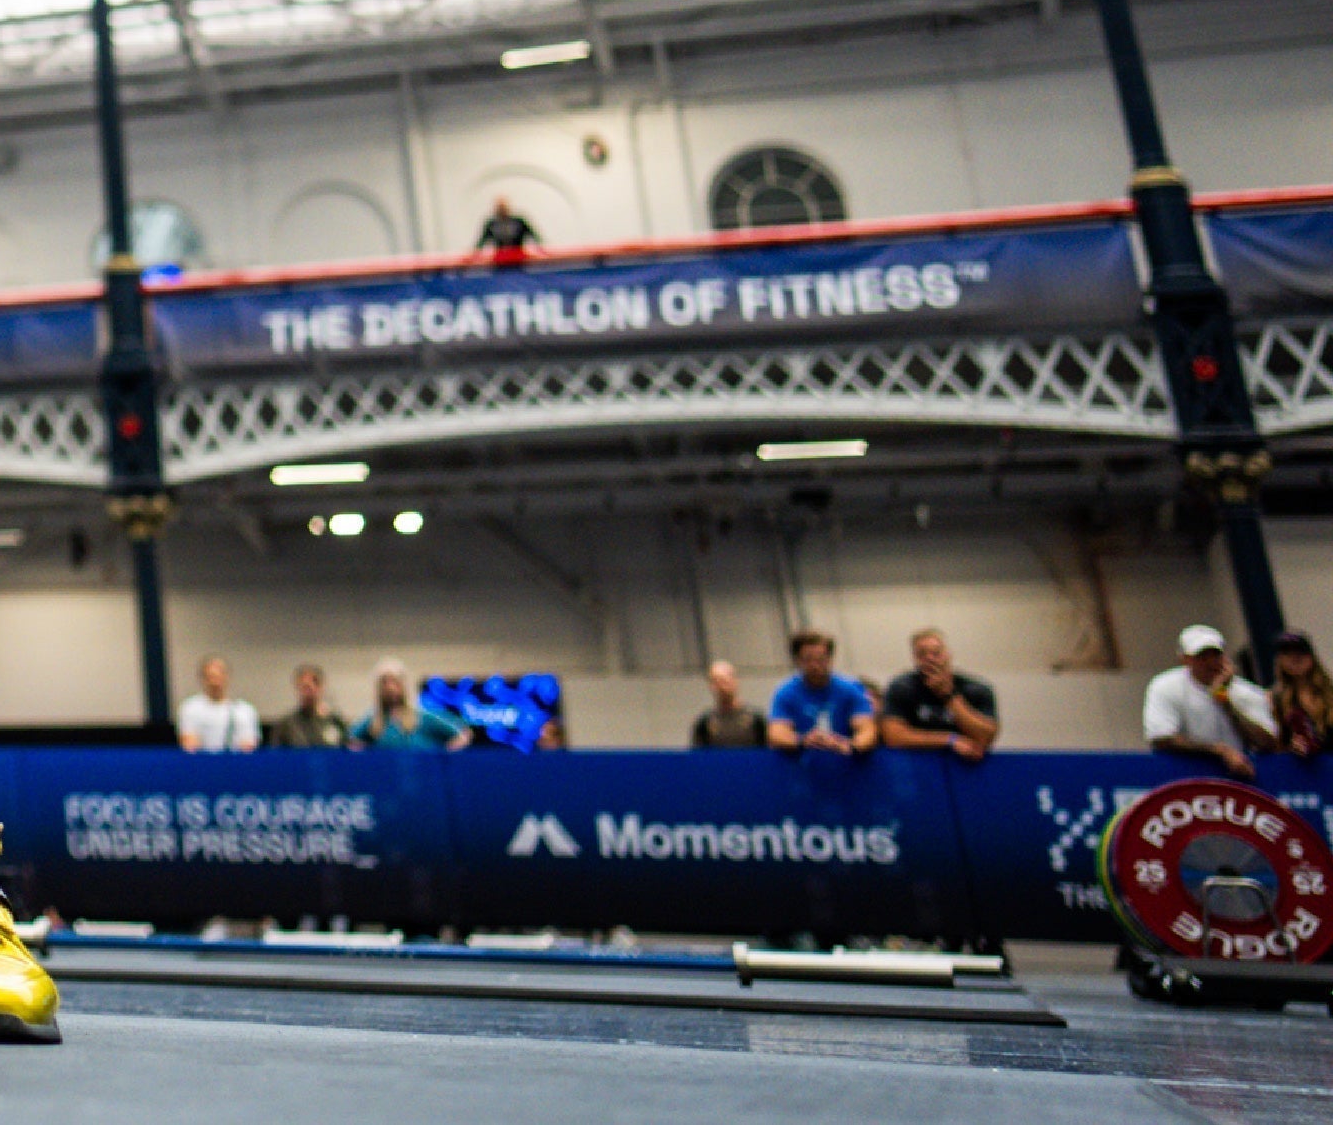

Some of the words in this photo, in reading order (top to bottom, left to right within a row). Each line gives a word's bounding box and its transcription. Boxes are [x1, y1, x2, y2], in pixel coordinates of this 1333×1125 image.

[261, 308, 353, 353] THE
[362, 286, 649, 347] DECATHLON
[658, 280, 726, 326] OF
[64, 792, 172, 829] FOCUS
[176, 793, 210, 828] IS
[213, 793, 374, 831] COURAGE
[1140, 795, 1287, 849] ROGUE
[65, 829, 177, 862] UNDER
[595, 812, 899, 864] Momentous
